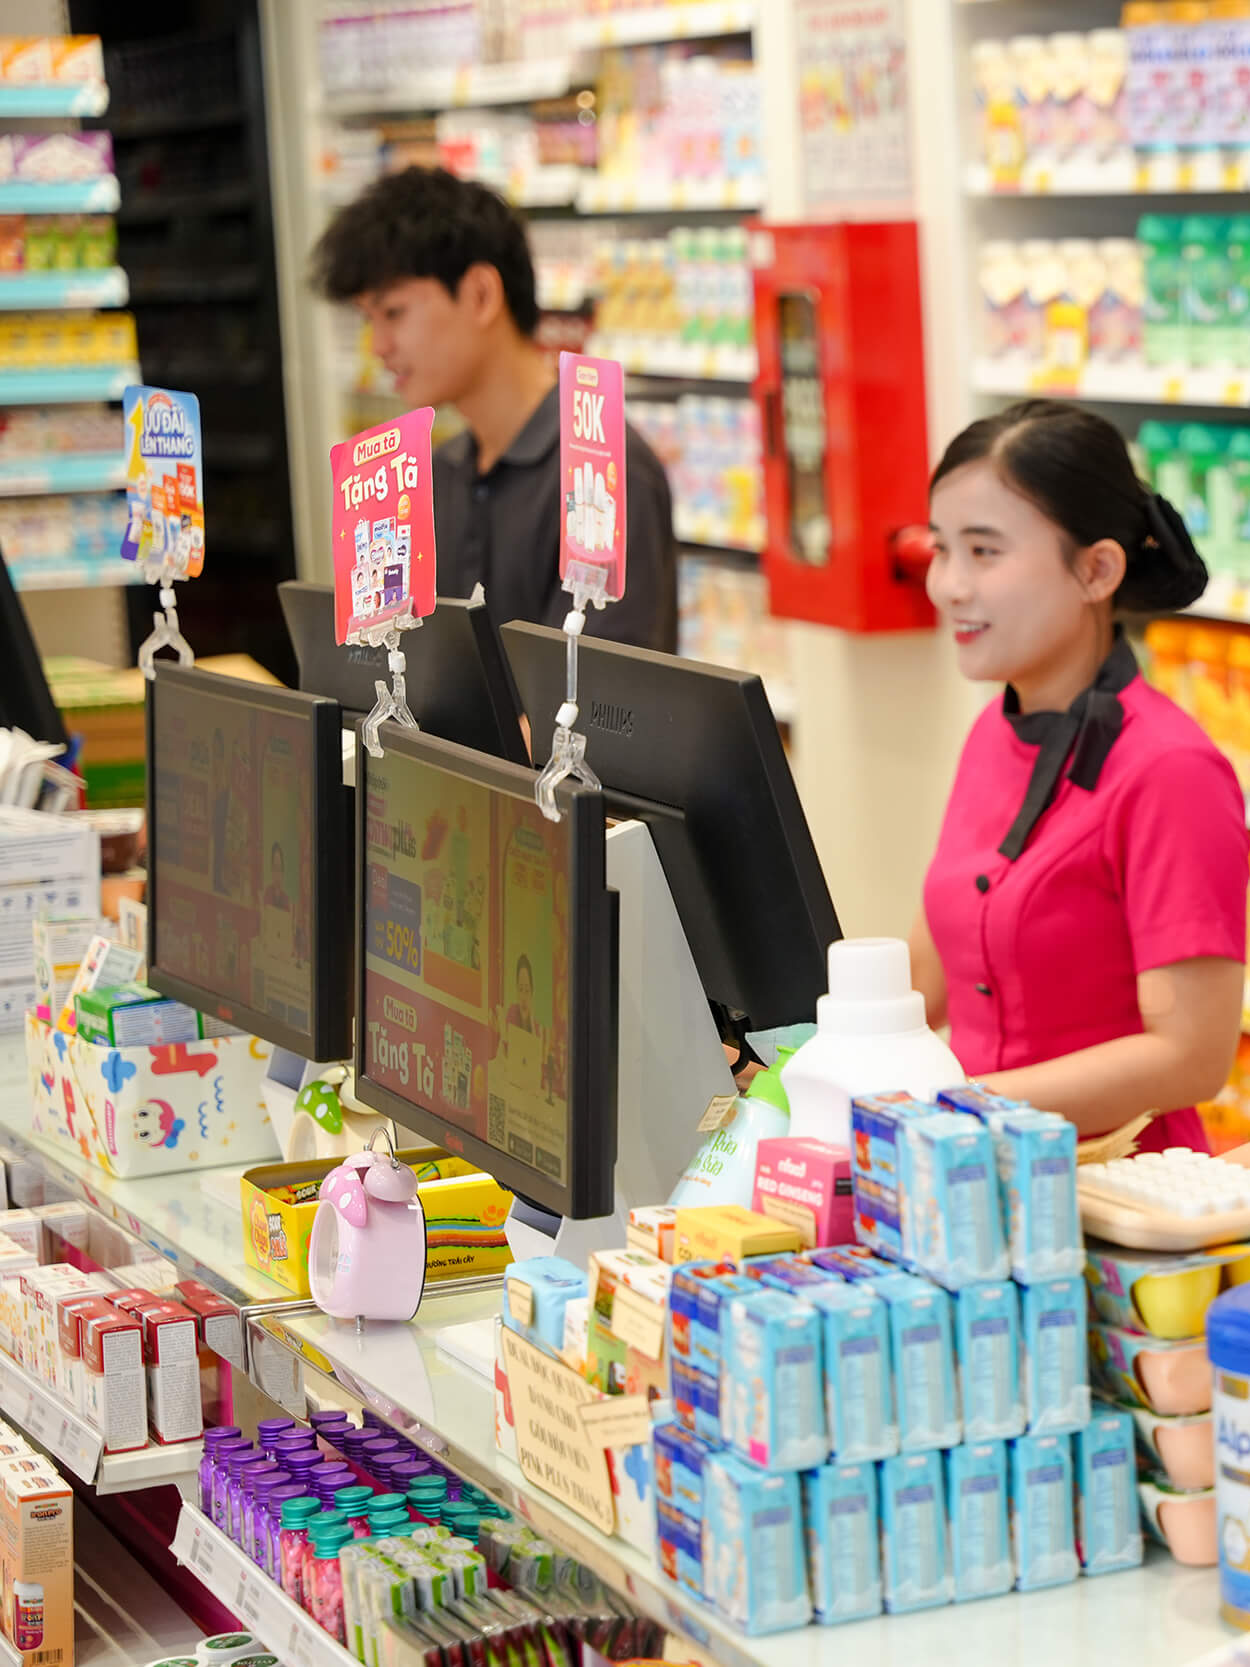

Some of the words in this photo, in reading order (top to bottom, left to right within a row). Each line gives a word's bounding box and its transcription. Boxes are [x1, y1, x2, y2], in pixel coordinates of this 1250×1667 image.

[573, 388, 606, 444] 50K
[357, 442, 381, 462] Mua
[384, 431, 397, 451] tã
[340, 465, 389, 512] Tặng
[390, 451, 419, 493] Tã
[590, 701, 634, 737] PHILIPS
[387, 919, 419, 969] 50%
[368, 1020, 409, 1086] Tặng
